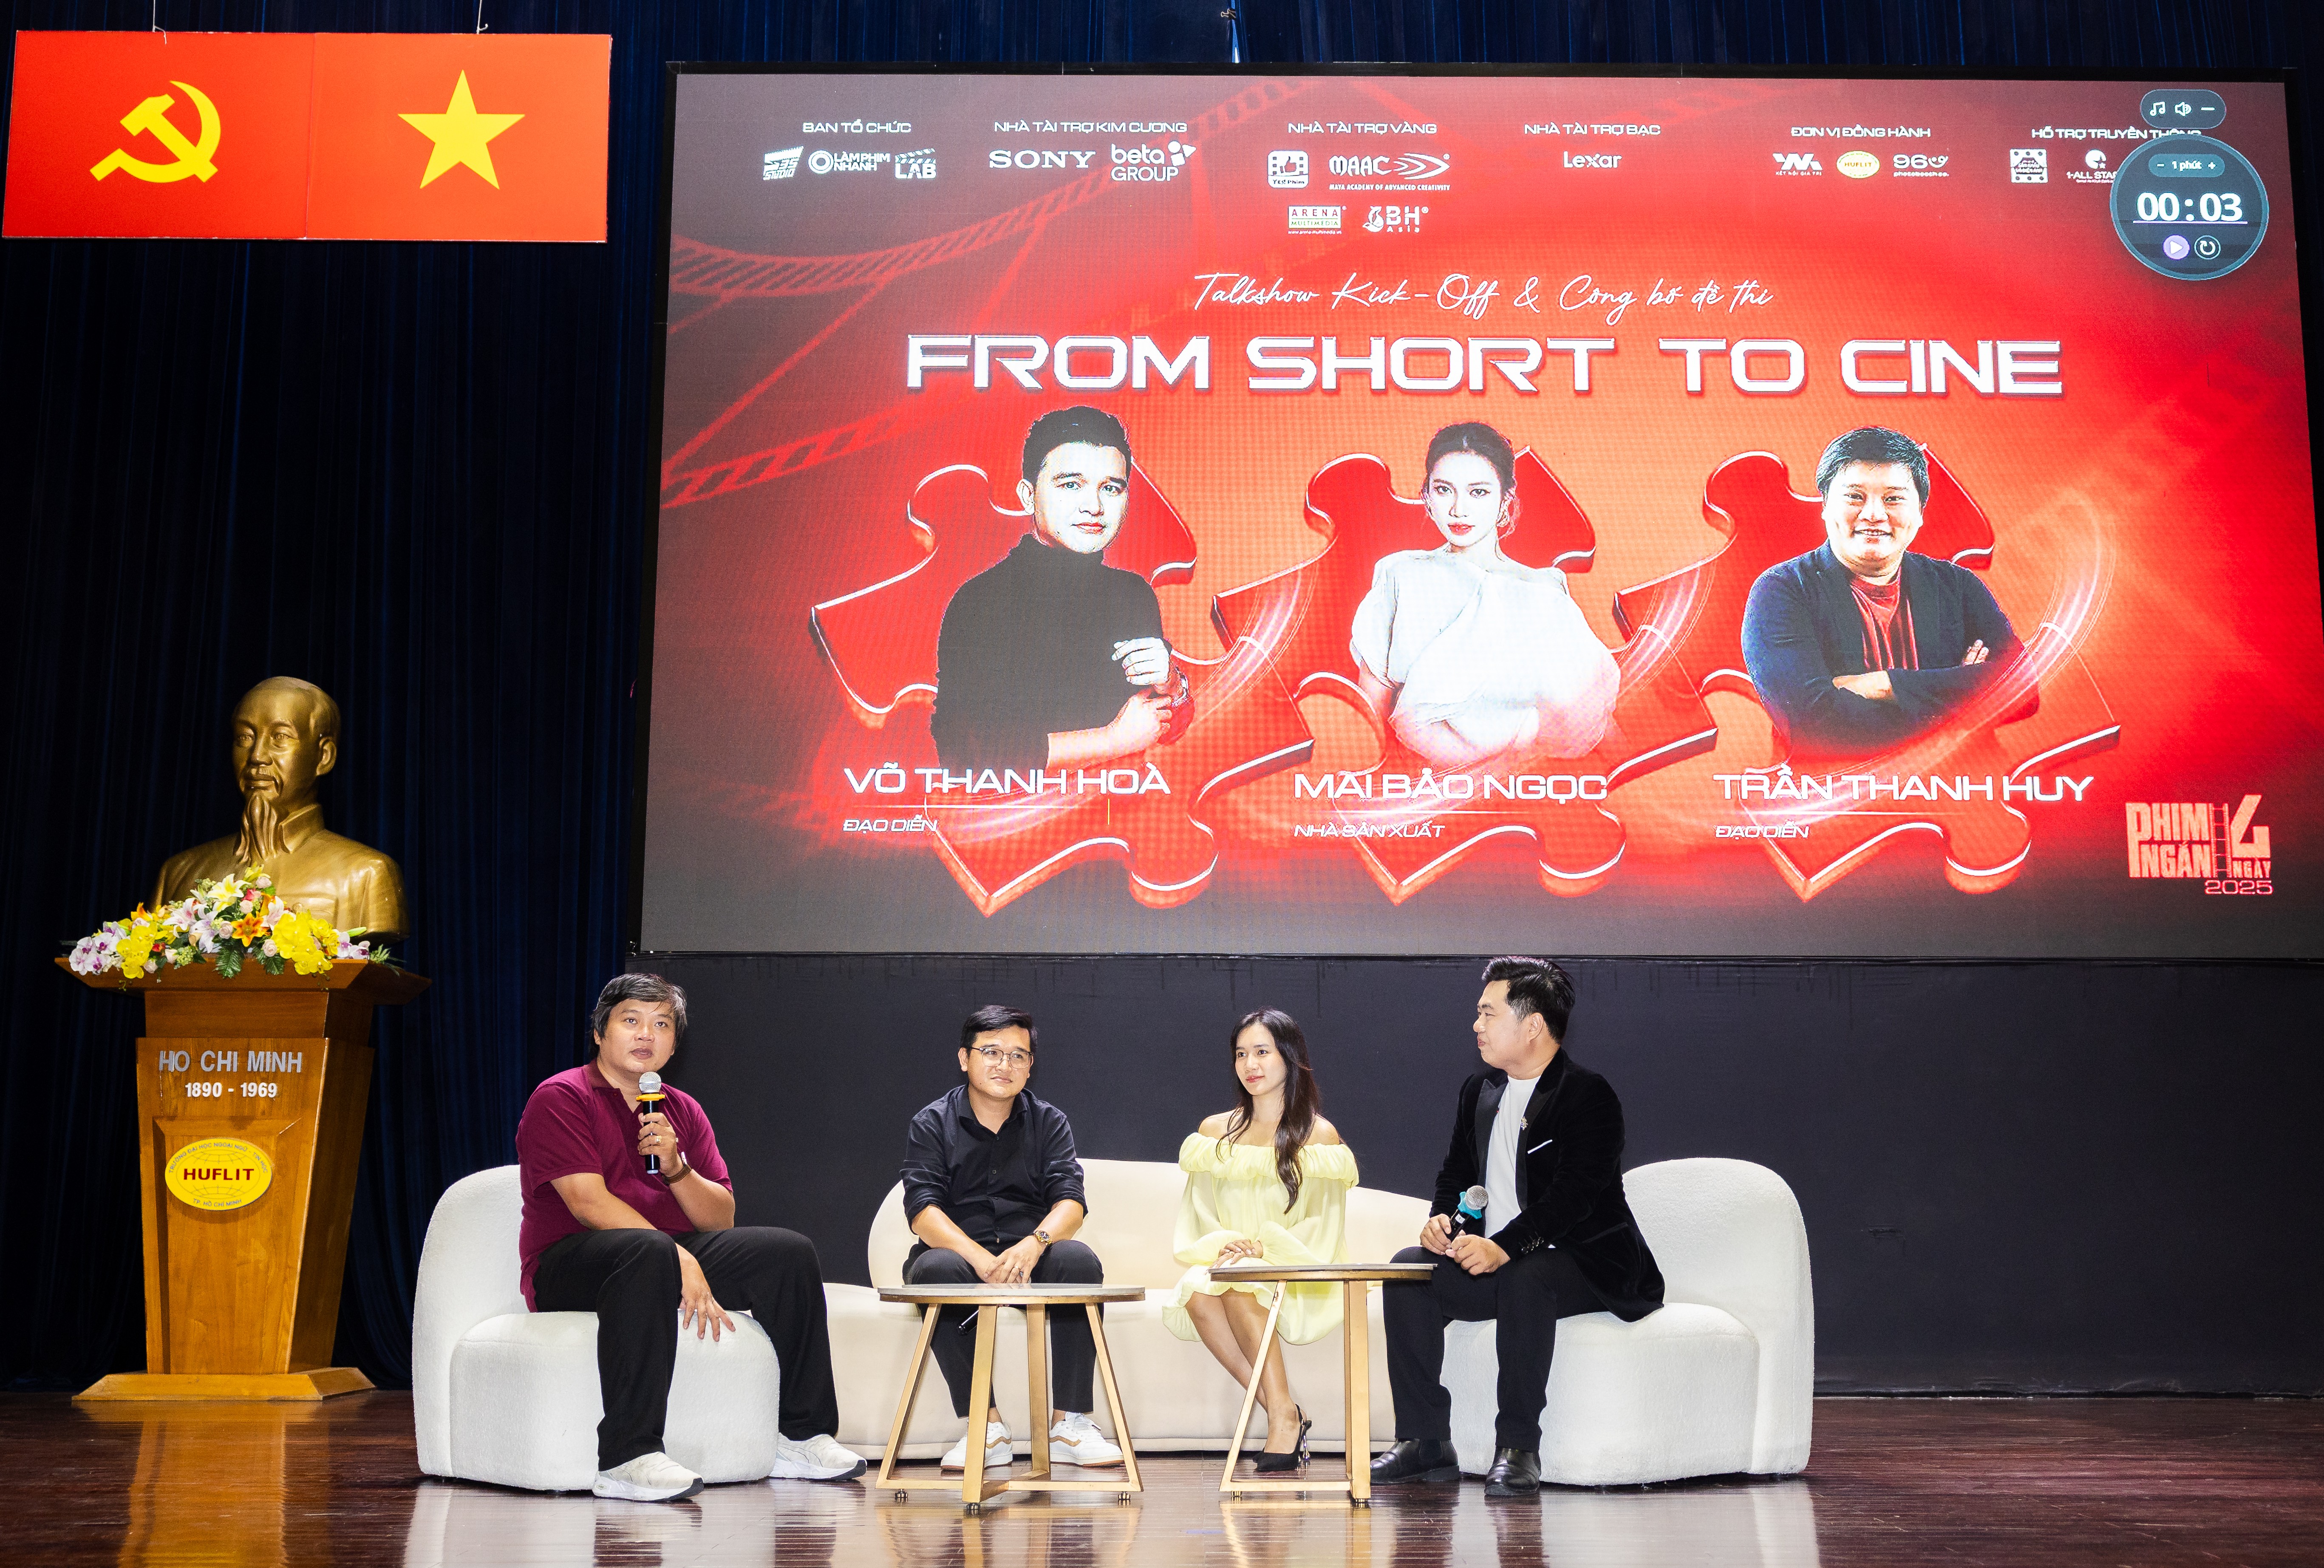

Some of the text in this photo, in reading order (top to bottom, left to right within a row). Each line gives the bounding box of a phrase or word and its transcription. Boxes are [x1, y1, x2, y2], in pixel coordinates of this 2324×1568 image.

[803, 122, 838, 133] BAN
[866, 120, 912, 133] CHỨC
[994, 119, 1030, 132] NHÀ
[1032, 119, 1057, 133] TÀI
[1096, 122, 1127, 133] KIM
[1288, 121, 1325, 133] NHÀ
[1326, 121, 1352, 133] TÀI
[1390, 121, 1438, 134] VÀNG
[1524, 122, 1561, 135] NHÀ
[1562, 122, 1588, 135] TÀI
[1626, 124, 1661, 136] BẠC
[1887, 125, 1931, 137] HÀNH
[833, 150, 891, 163] LÀM PHIM
[989, 150, 1096, 169] SONY
[1111, 143, 1165, 164] beta
[1563, 150, 1622, 168] Lexar
[833, 162, 878, 171] NHANH
[895, 163, 937, 179] LAB
[1329, 155, 1392, 177] MAAC
[2171, 159, 2202, 172] 1 phút
[763, 168, 796, 181] STUDIO
[1110, 166, 1179, 181] GROUP
[1292, 209, 1338, 217] ARENA
[1386, 205, 1420, 226] BH
[1386, 225, 1420, 233] Asia
[1194, 272, 1320, 310] Talkshow
[1513, 275, 1541, 313] &
[1559, 274, 1638, 326] Công
[1646, 277, 1684, 306] bố
[1691, 279, 1725, 312] đề
[1729, 279, 1774, 313] thi
[906, 334, 2063, 395] FROM SHORT TO CINE
[843, 761, 1172, 795] VÕ THANH HOÀ
[1713, 762, 2095, 801] TRẦN THANH HUY
[1294, 767, 1608, 805] MAI BẢO NGỌC
[843, 813, 938, 834] ĐẠO DIỄN
[1294, 822, 1339, 838] NHÀ
[1387, 820, 1446, 838] XUẤT
[1715, 825, 1760, 840] ĐẠO
[2205, 880, 2274, 895] 2025
[159, 1050, 303, 1073] HO CHI MINH
[185, 1082, 222, 1098] 1890
[240, 1082, 277, 1098] 1969
[183, 1168, 254, 1180] HUFLIT
